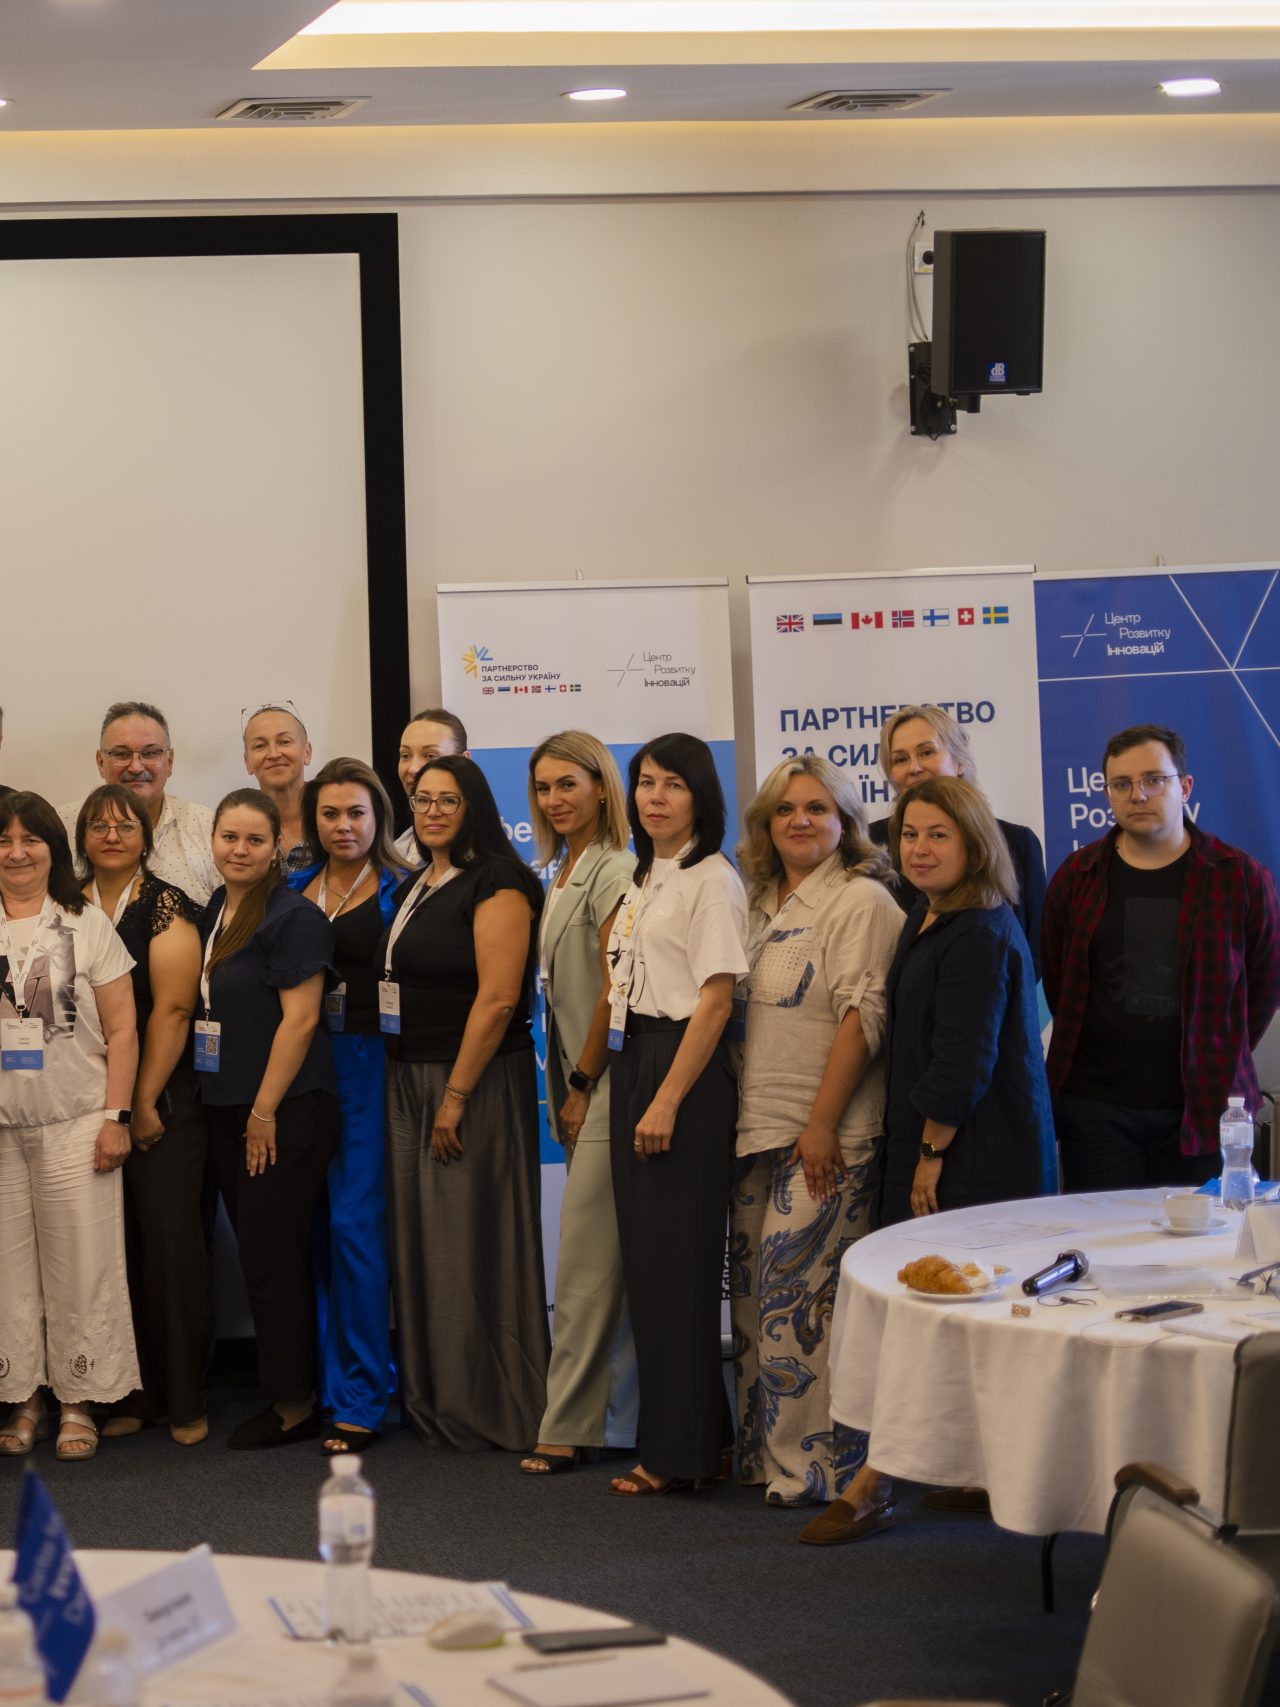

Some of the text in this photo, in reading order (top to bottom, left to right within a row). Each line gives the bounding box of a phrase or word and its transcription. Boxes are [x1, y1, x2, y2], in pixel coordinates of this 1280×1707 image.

[990, 362, 1005, 376] dB
[1104, 611, 1142, 626] Центр
[1119, 627, 1171, 640] Розвитку
[1107, 641, 1165, 656] Інновацій
[642, 651, 672, 663] Центр
[481, 664, 539, 673] ПАРТНЕРСТВО
[654, 664, 696, 675] Розвитку
[493, 674, 527, 682] СИЛЬНУ
[528, 671, 561, 681] УКРАЇНУ
[644, 676, 690, 687] Інновацій
[780, 700, 996, 733] ПАРТНЕТВО
